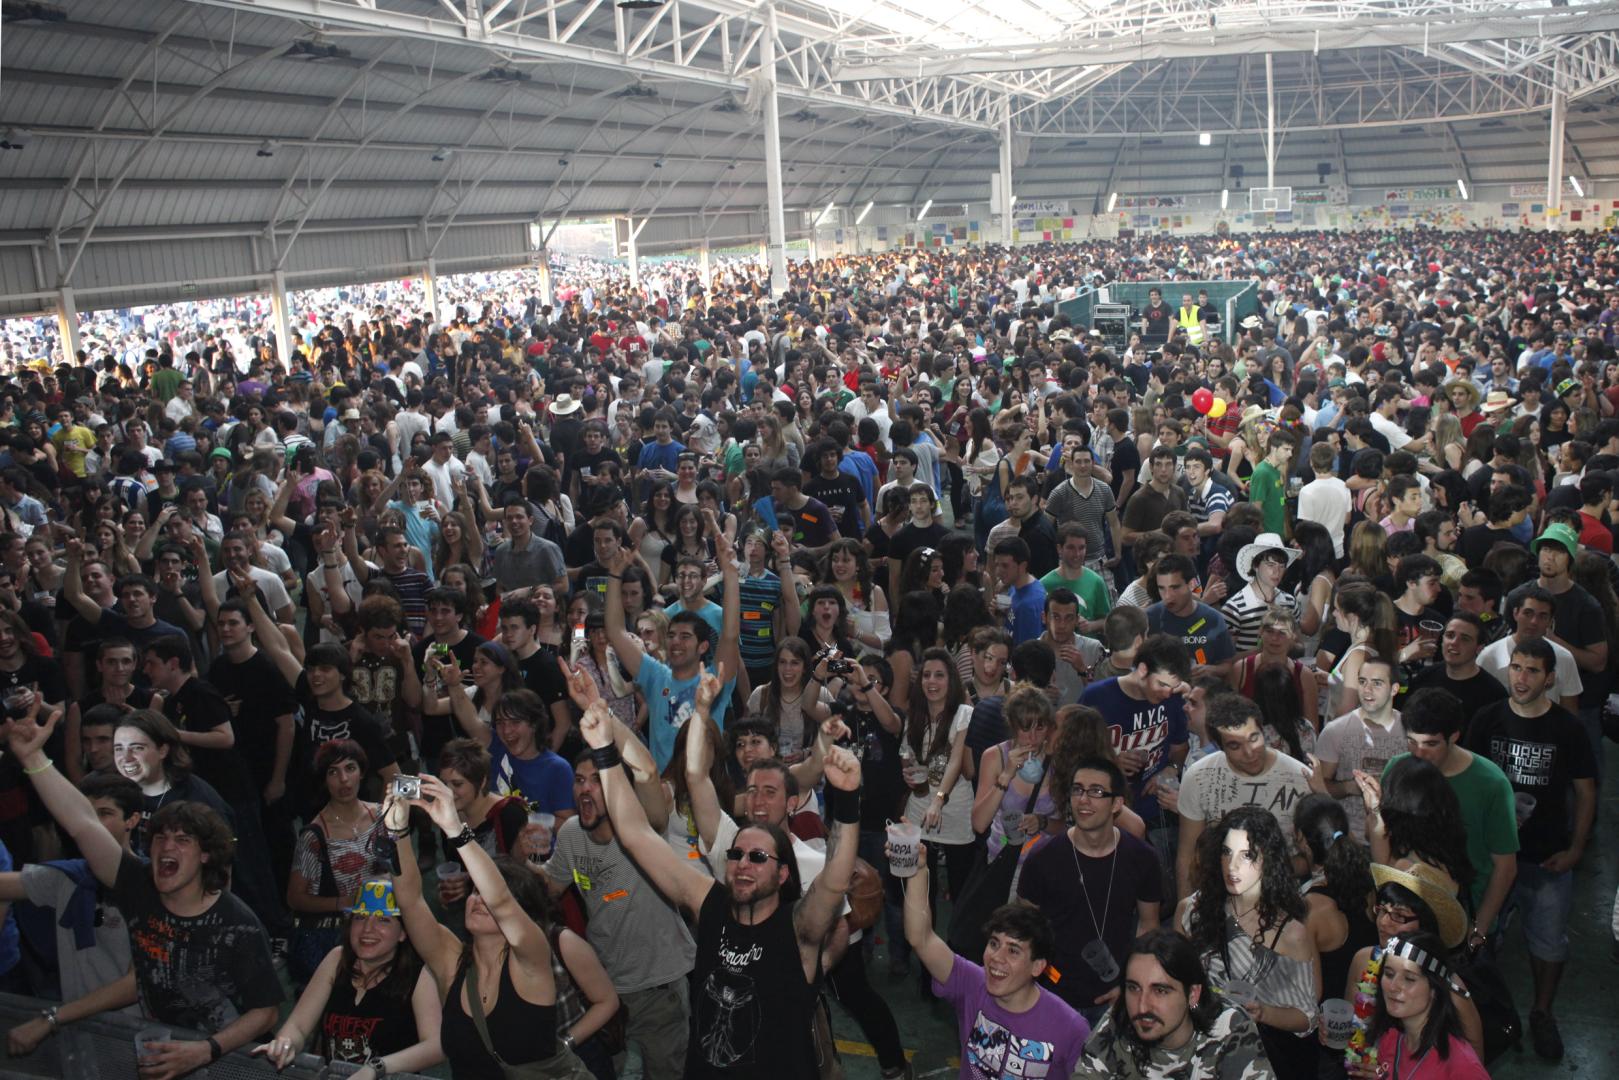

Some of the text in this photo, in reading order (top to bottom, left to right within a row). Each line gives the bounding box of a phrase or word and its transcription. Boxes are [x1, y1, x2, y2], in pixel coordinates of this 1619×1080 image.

[1133, 704, 1168, 731] N.Y.C.
[1104, 720, 1169, 756] PIZZA
[1241, 781, 1269, 807] I
